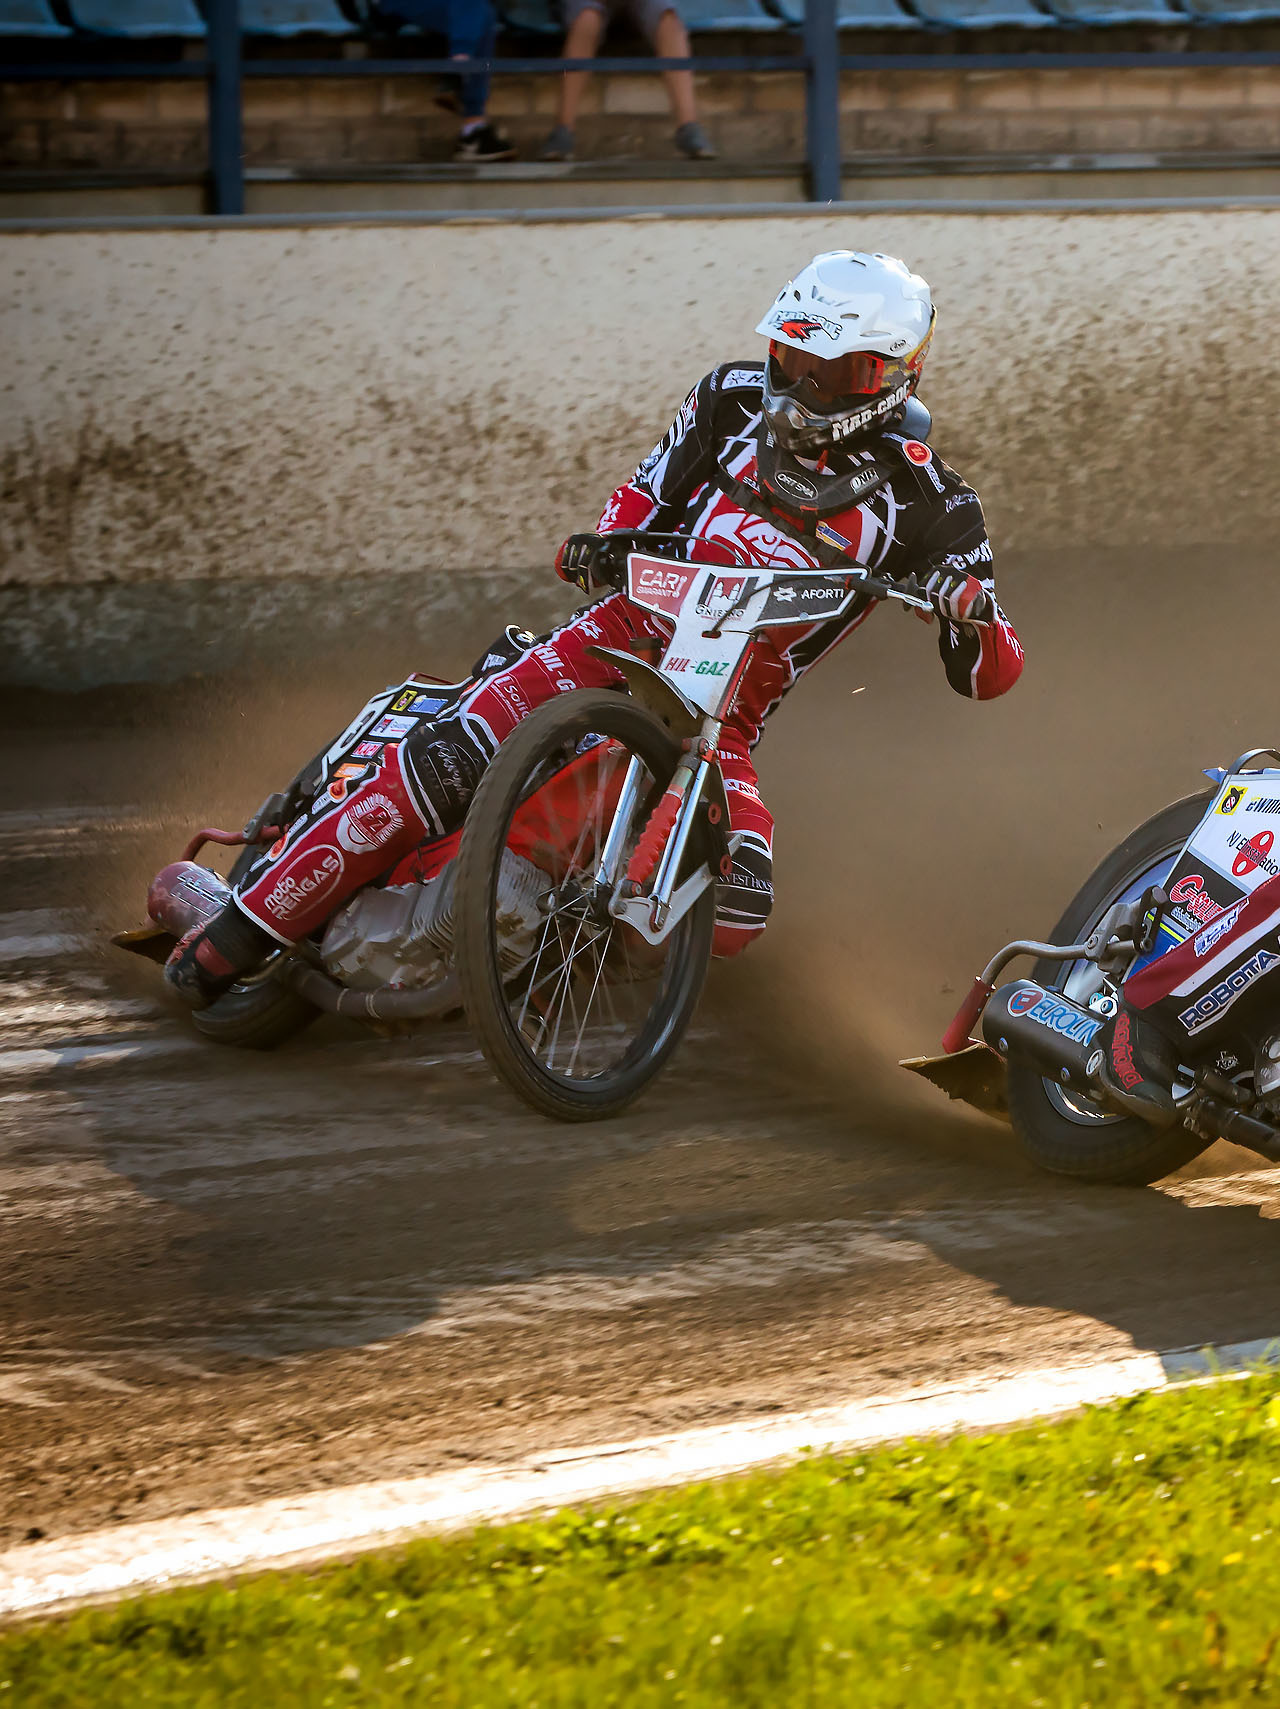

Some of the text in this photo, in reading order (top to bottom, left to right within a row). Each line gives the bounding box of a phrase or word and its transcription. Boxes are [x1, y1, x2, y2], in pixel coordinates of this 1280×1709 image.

[800, 588, 845, 600] AFORTI
[533, 646, 577, 692] HIL-G
[264, 876, 295, 910] moto
[272, 855, 340, 919] RENGAS
[1178, 949, 1280, 1030] ROBOTA
[1026, 997, 1104, 1048] EUROLIN
